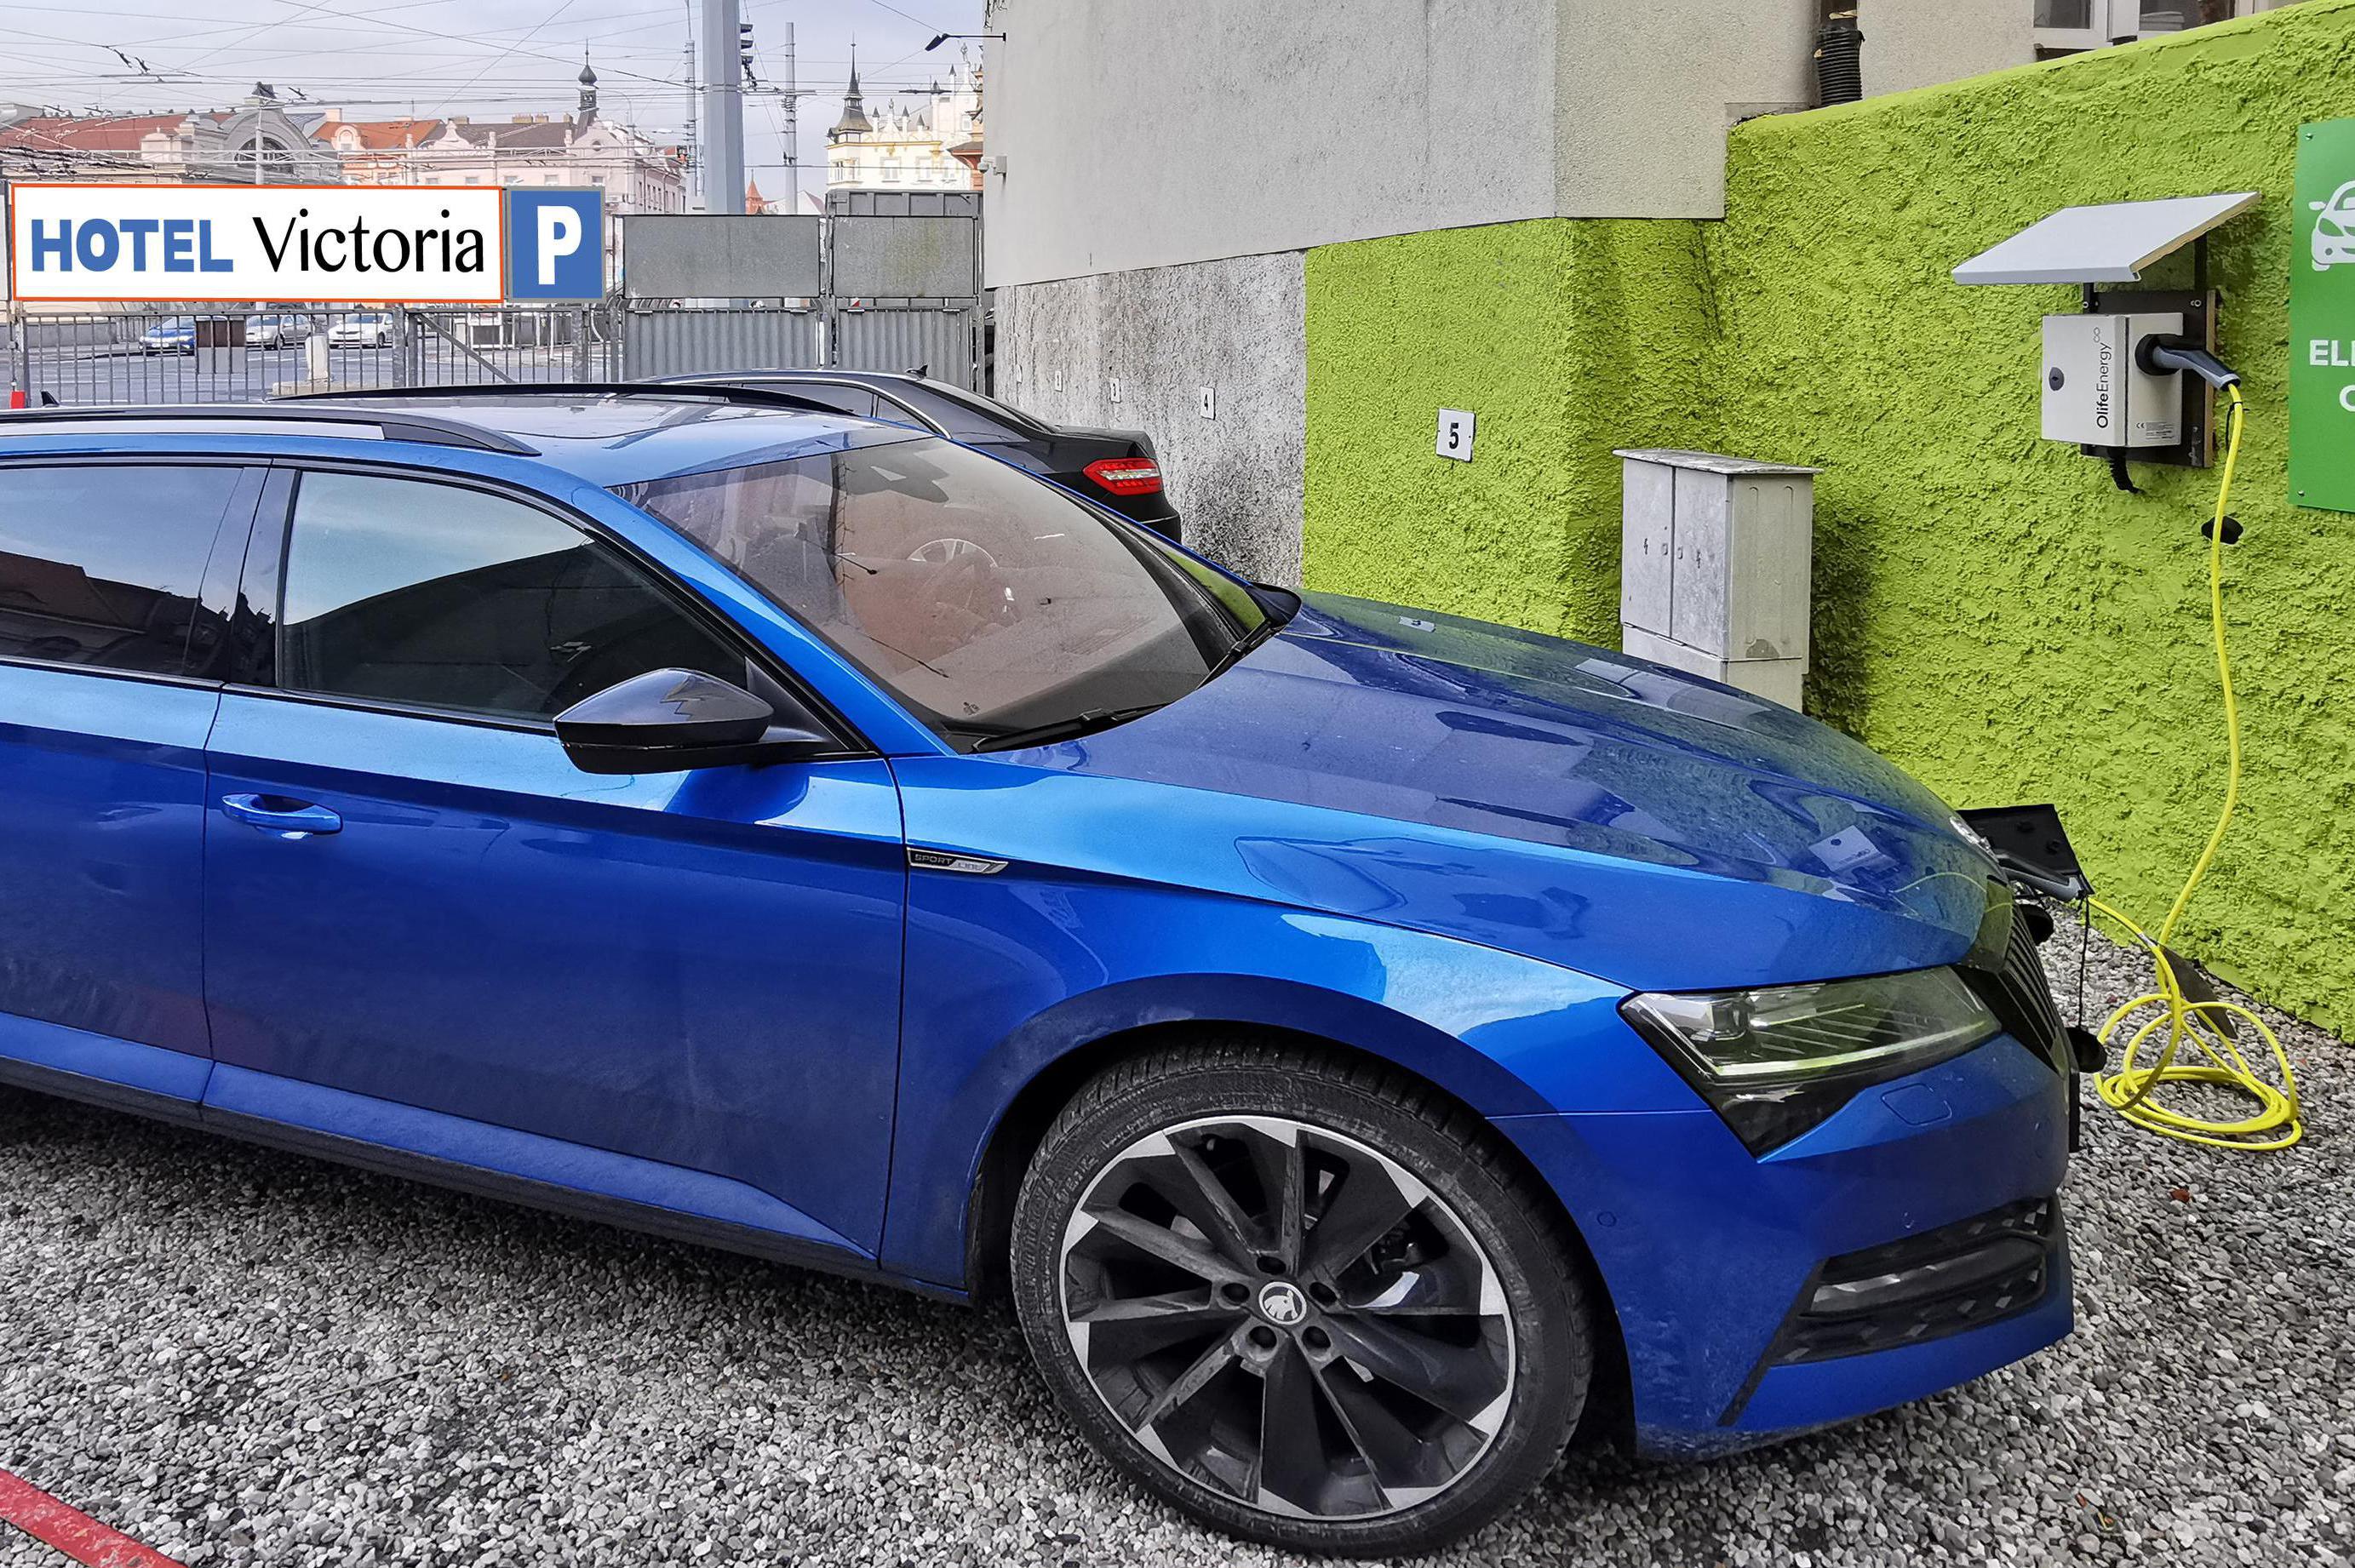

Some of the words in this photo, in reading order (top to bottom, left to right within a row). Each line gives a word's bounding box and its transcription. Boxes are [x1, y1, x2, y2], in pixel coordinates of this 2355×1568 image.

[32, 219, 233, 272] HOTEL
[253, 209, 484, 272] Victoria
[537, 205, 582, 285] P
[1448, 422, 1459, 449] 5
[914, 854, 954, 865] SPORT
